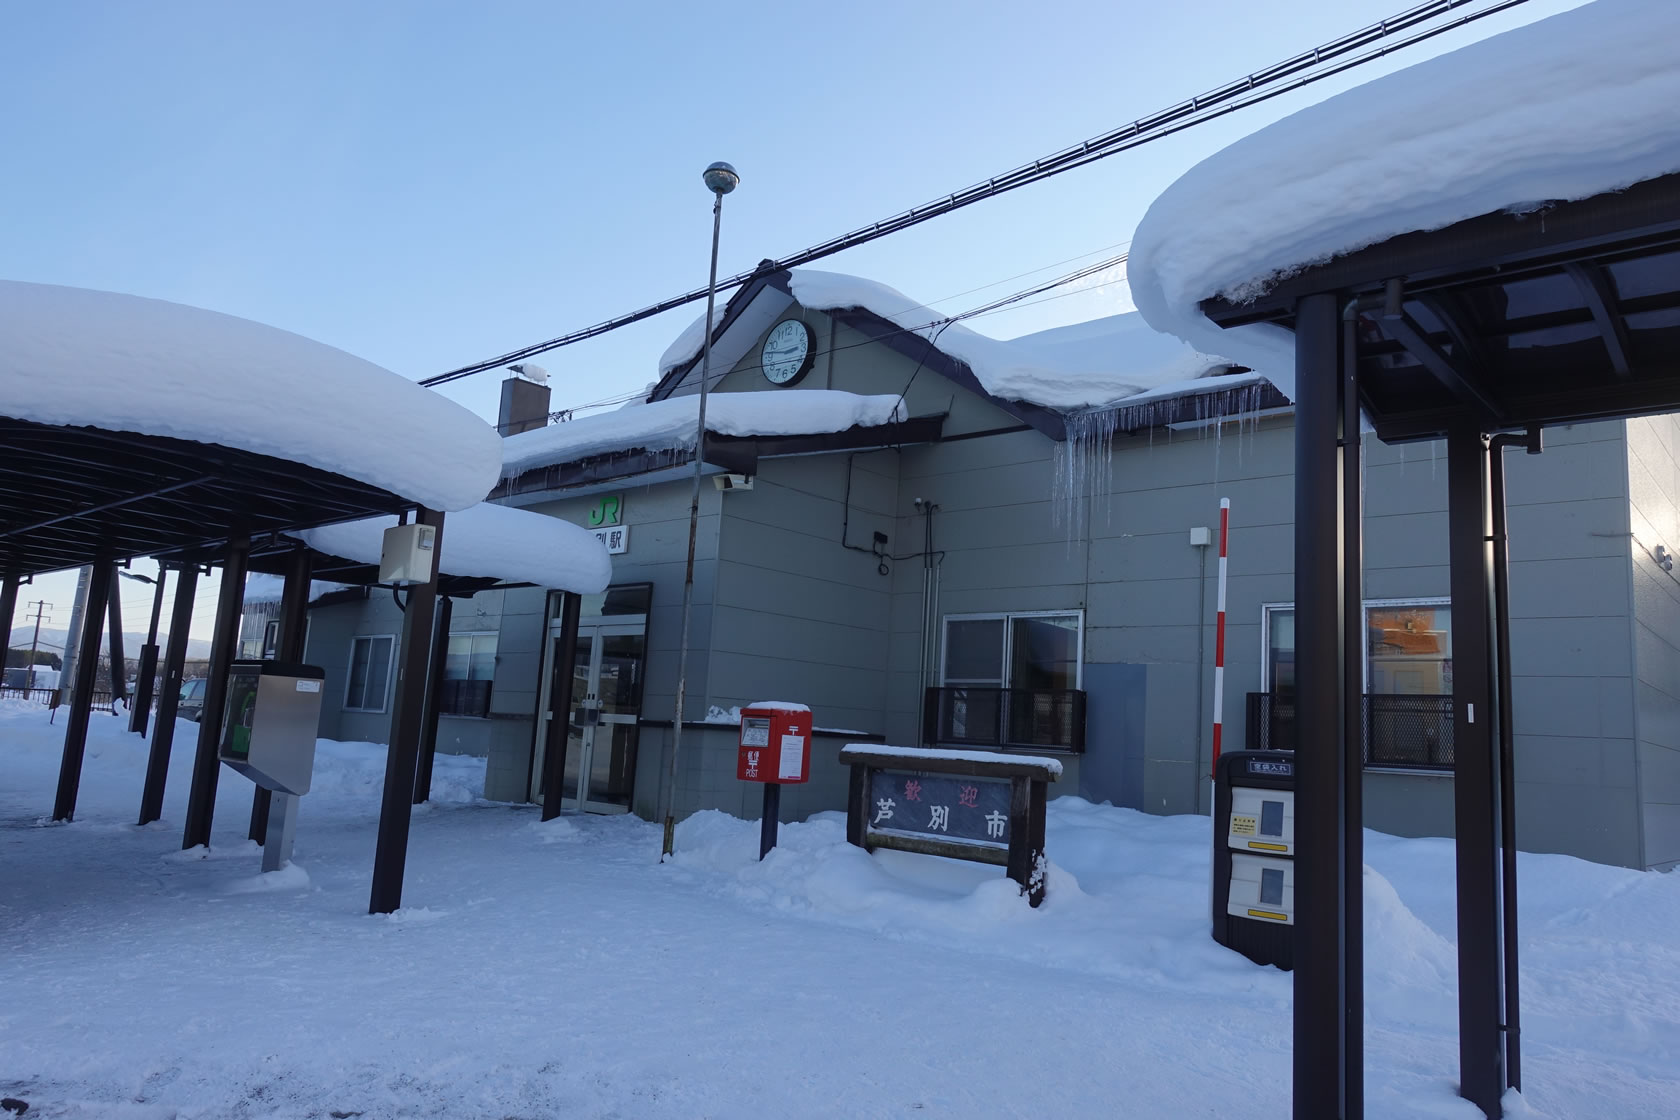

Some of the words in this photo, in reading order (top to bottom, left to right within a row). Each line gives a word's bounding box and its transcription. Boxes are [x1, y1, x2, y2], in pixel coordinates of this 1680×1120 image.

[777, 330, 784, 340] 11
[785, 326, 792, 336] 12
[800, 332, 805, 342] 2
[769, 340, 778, 350] 10
[801, 343, 806, 353] 3
[769, 361, 776, 371] 8
[790, 364, 796, 374] 5
[775, 368, 781, 378] 7
[782, 369, 788, 379] 6
[589, 496, 618, 525] JR
[745, 769, 758, 777] POST
[874, 798, 1008, 839] 芦別市
